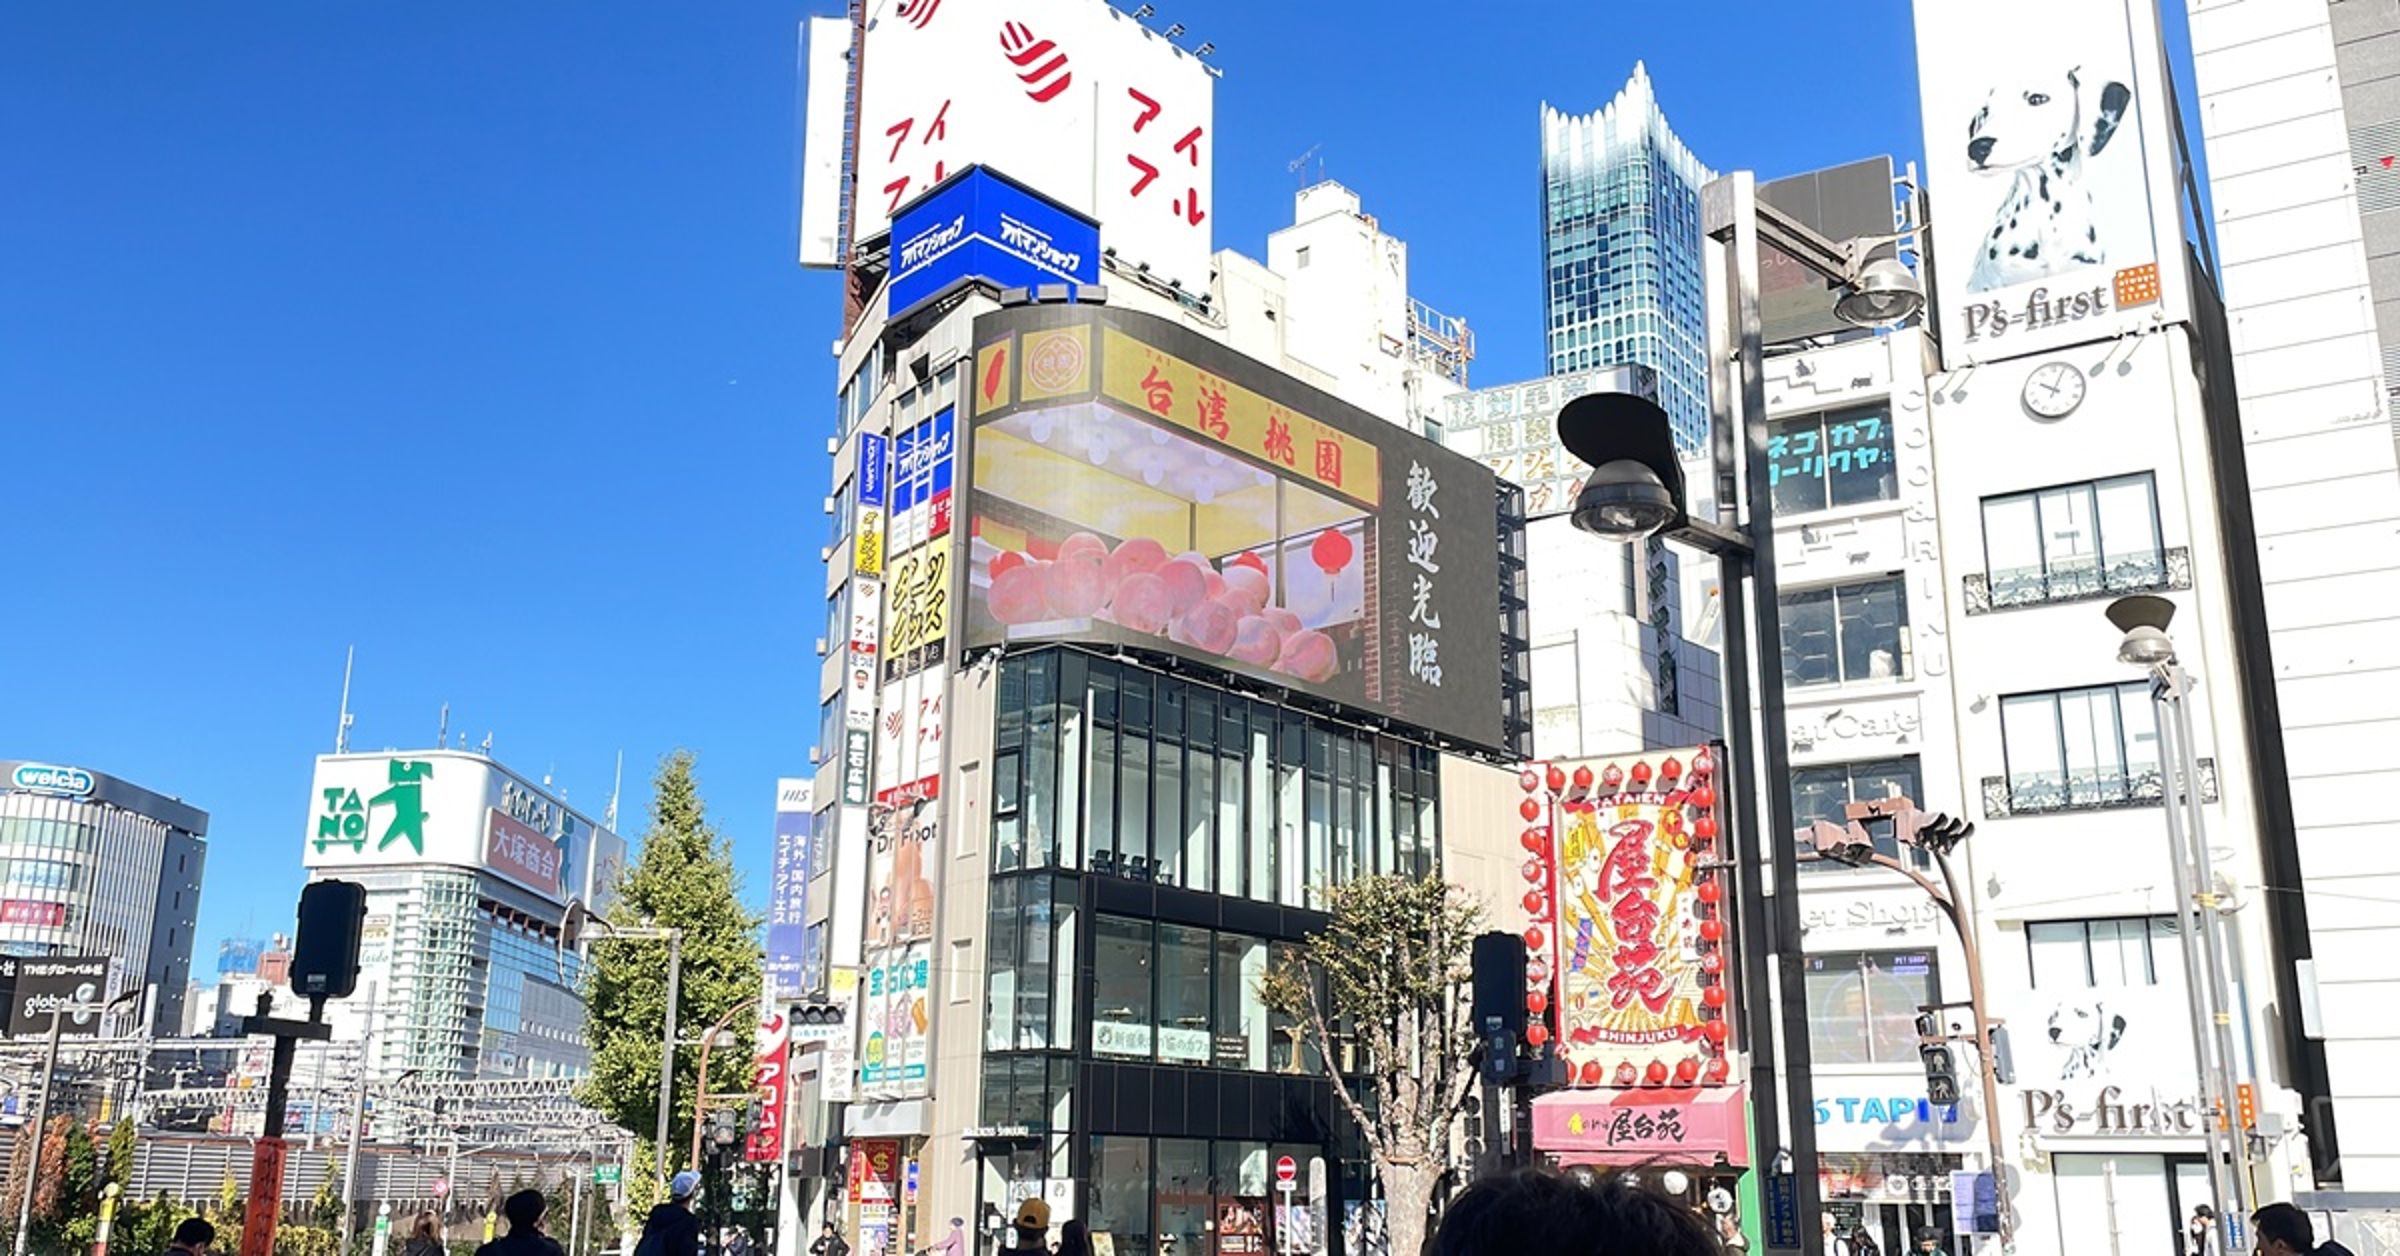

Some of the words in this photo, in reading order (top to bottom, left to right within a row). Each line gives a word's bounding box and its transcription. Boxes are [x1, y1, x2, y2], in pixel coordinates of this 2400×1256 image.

[1964, 286, 2107, 341] P's-first
[21, 768, 86, 790] welcia
[493, 828, 555, 881] 大塚商会
[1606, 1107, 1689, 1147] 屋台苑
